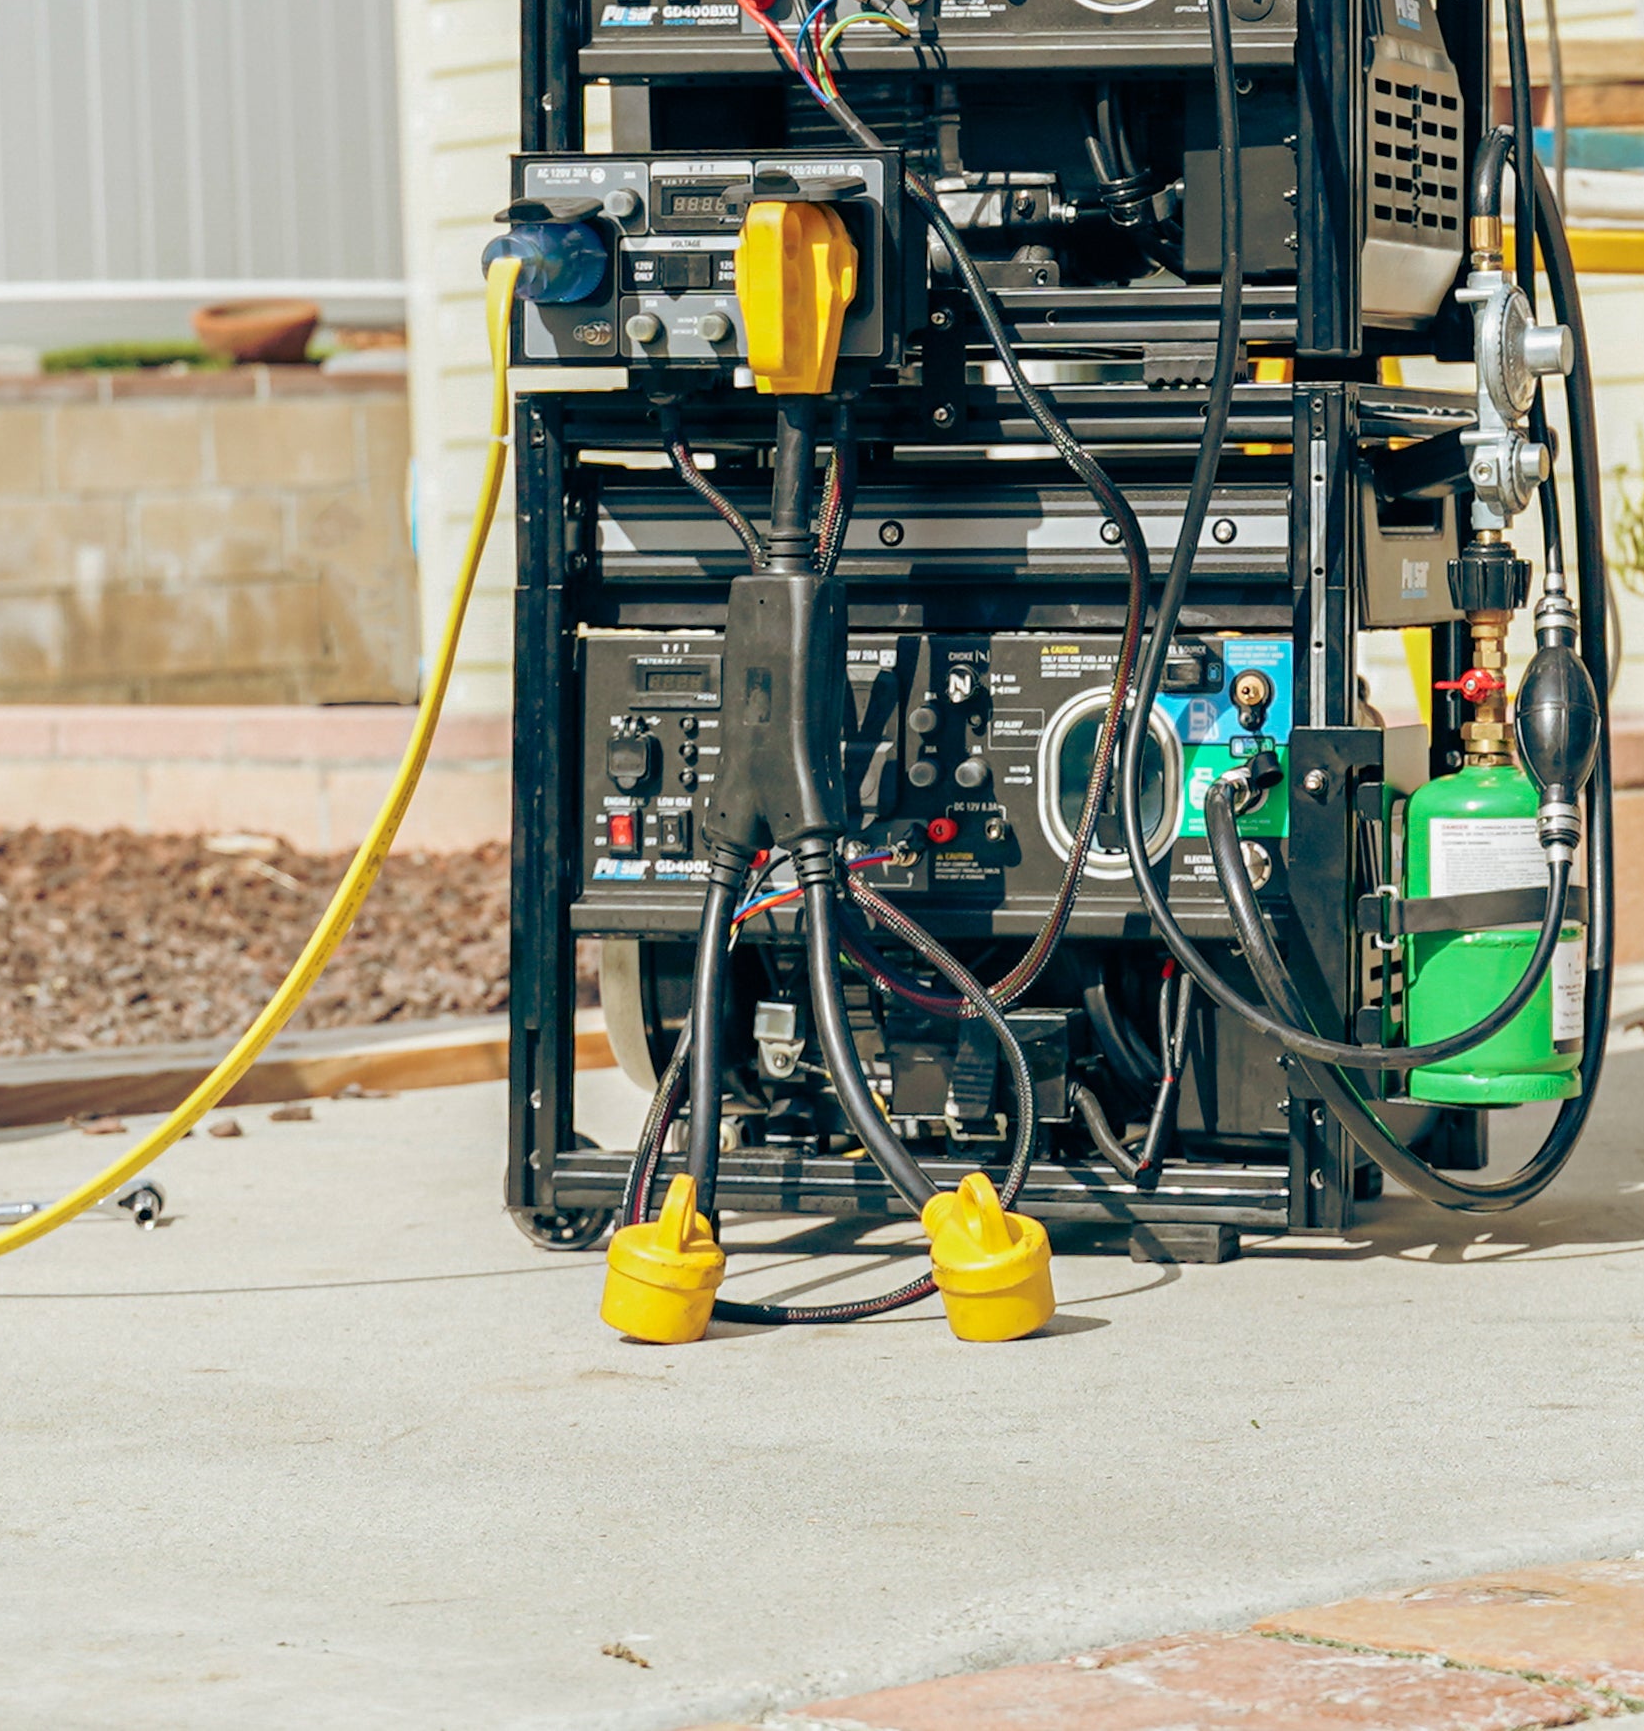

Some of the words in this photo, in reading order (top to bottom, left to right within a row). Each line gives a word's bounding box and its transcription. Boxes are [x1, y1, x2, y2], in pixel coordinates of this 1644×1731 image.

[663, 5, 739, 17] GD400BXU
[537, 168, 549, 178] AC
[550, 167, 571, 178] 120V
[670, 239, 702, 248] VOLTAGE
